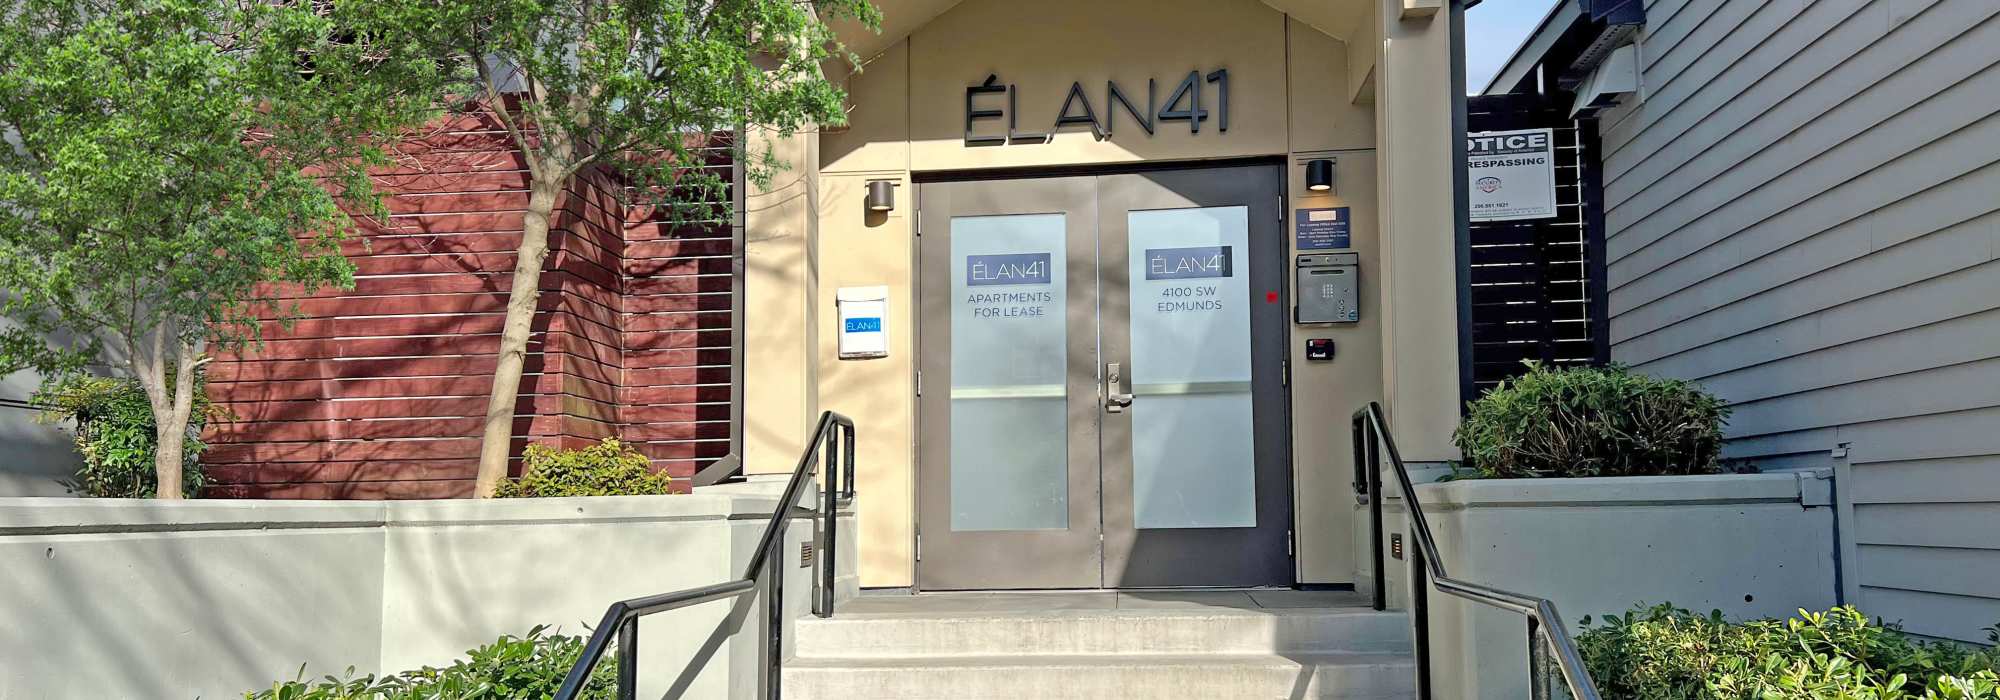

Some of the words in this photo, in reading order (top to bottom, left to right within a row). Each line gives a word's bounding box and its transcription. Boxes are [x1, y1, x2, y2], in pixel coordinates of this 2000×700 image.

[964, 69, 1229, 147] ÉLAN41
[973, 260, 1045, 280] ÉLAN41
[1151, 254, 1226, 274] ÉLAN41
[1162, 287, 1191, 297] 4100
[1195, 286, 1217, 296] SW
[967, 292, 1051, 304] APARTMENTS
[974, 308, 999, 318] FOR
[1003, 306, 1044, 317] LEASE
[1157, 300, 1222, 312] EDMUNDS
